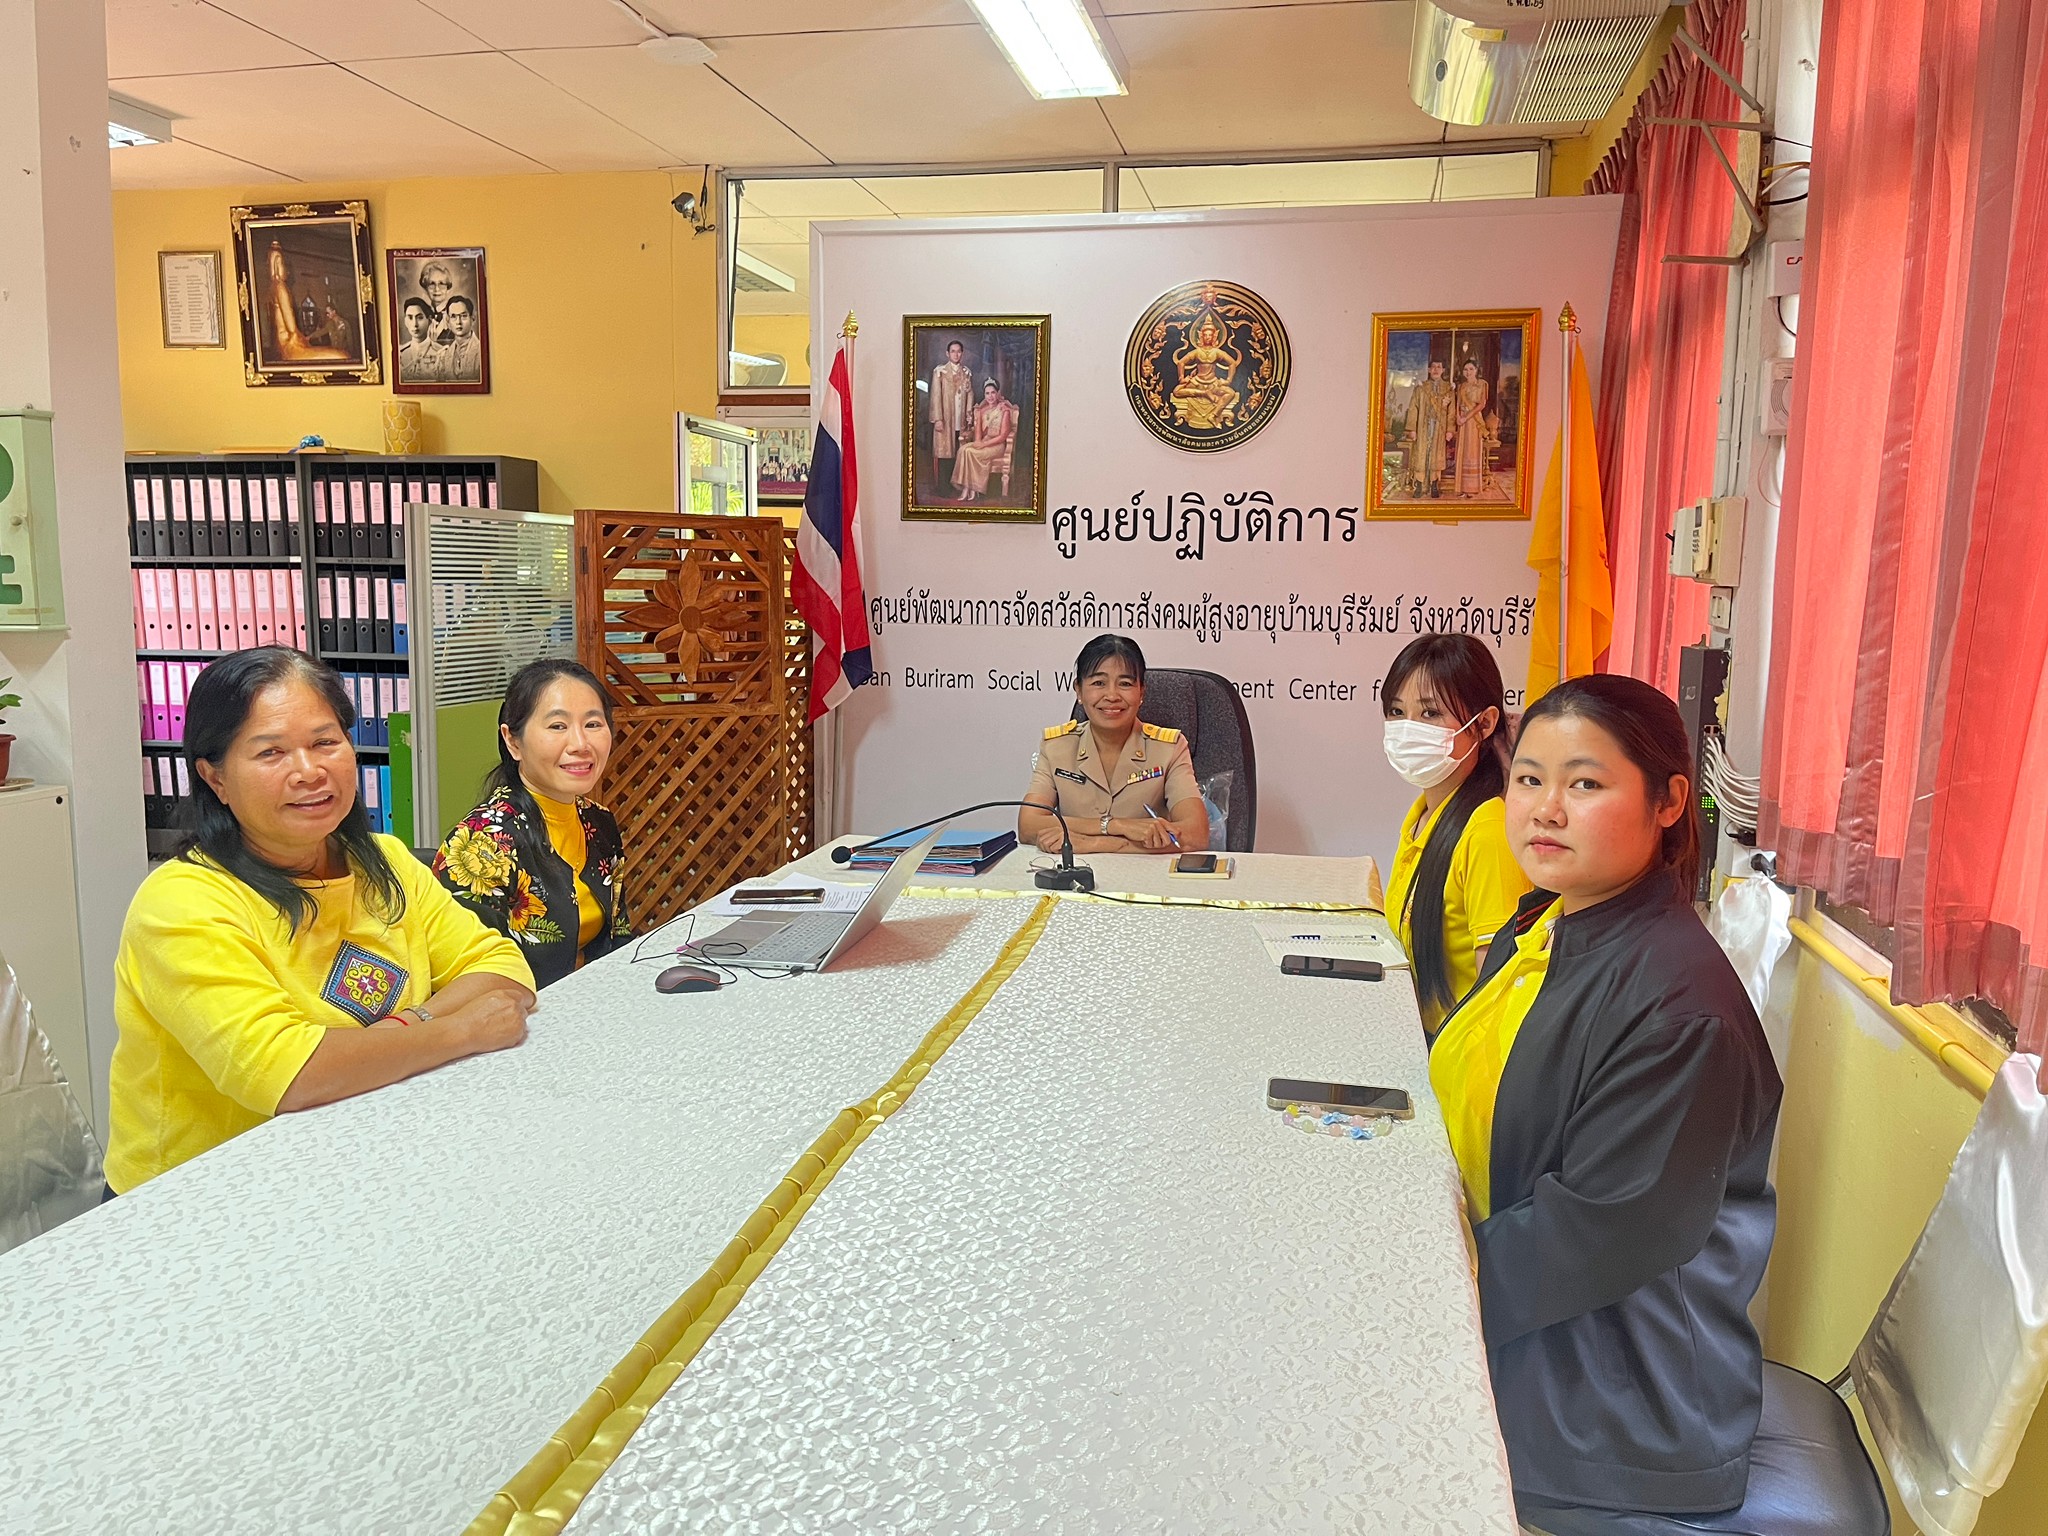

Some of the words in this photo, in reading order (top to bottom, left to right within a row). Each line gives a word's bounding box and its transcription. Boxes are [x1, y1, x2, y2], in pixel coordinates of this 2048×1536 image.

[1052, 490, 1359, 560] ศูนย์ปฏิบัติการ
[870, 586, 1405, 645] ศูนย์พัฒนาการจัดสวัสดิการสังคมผู้สูงอายุบ้านบุรีรัมย์
[1409, 594, 1536, 648] จังหวัดบุรีรั
[905, 667, 975, 690] Buriram
[988, 669, 1042, 692] Social
[1289, 678, 1358, 701] Center
